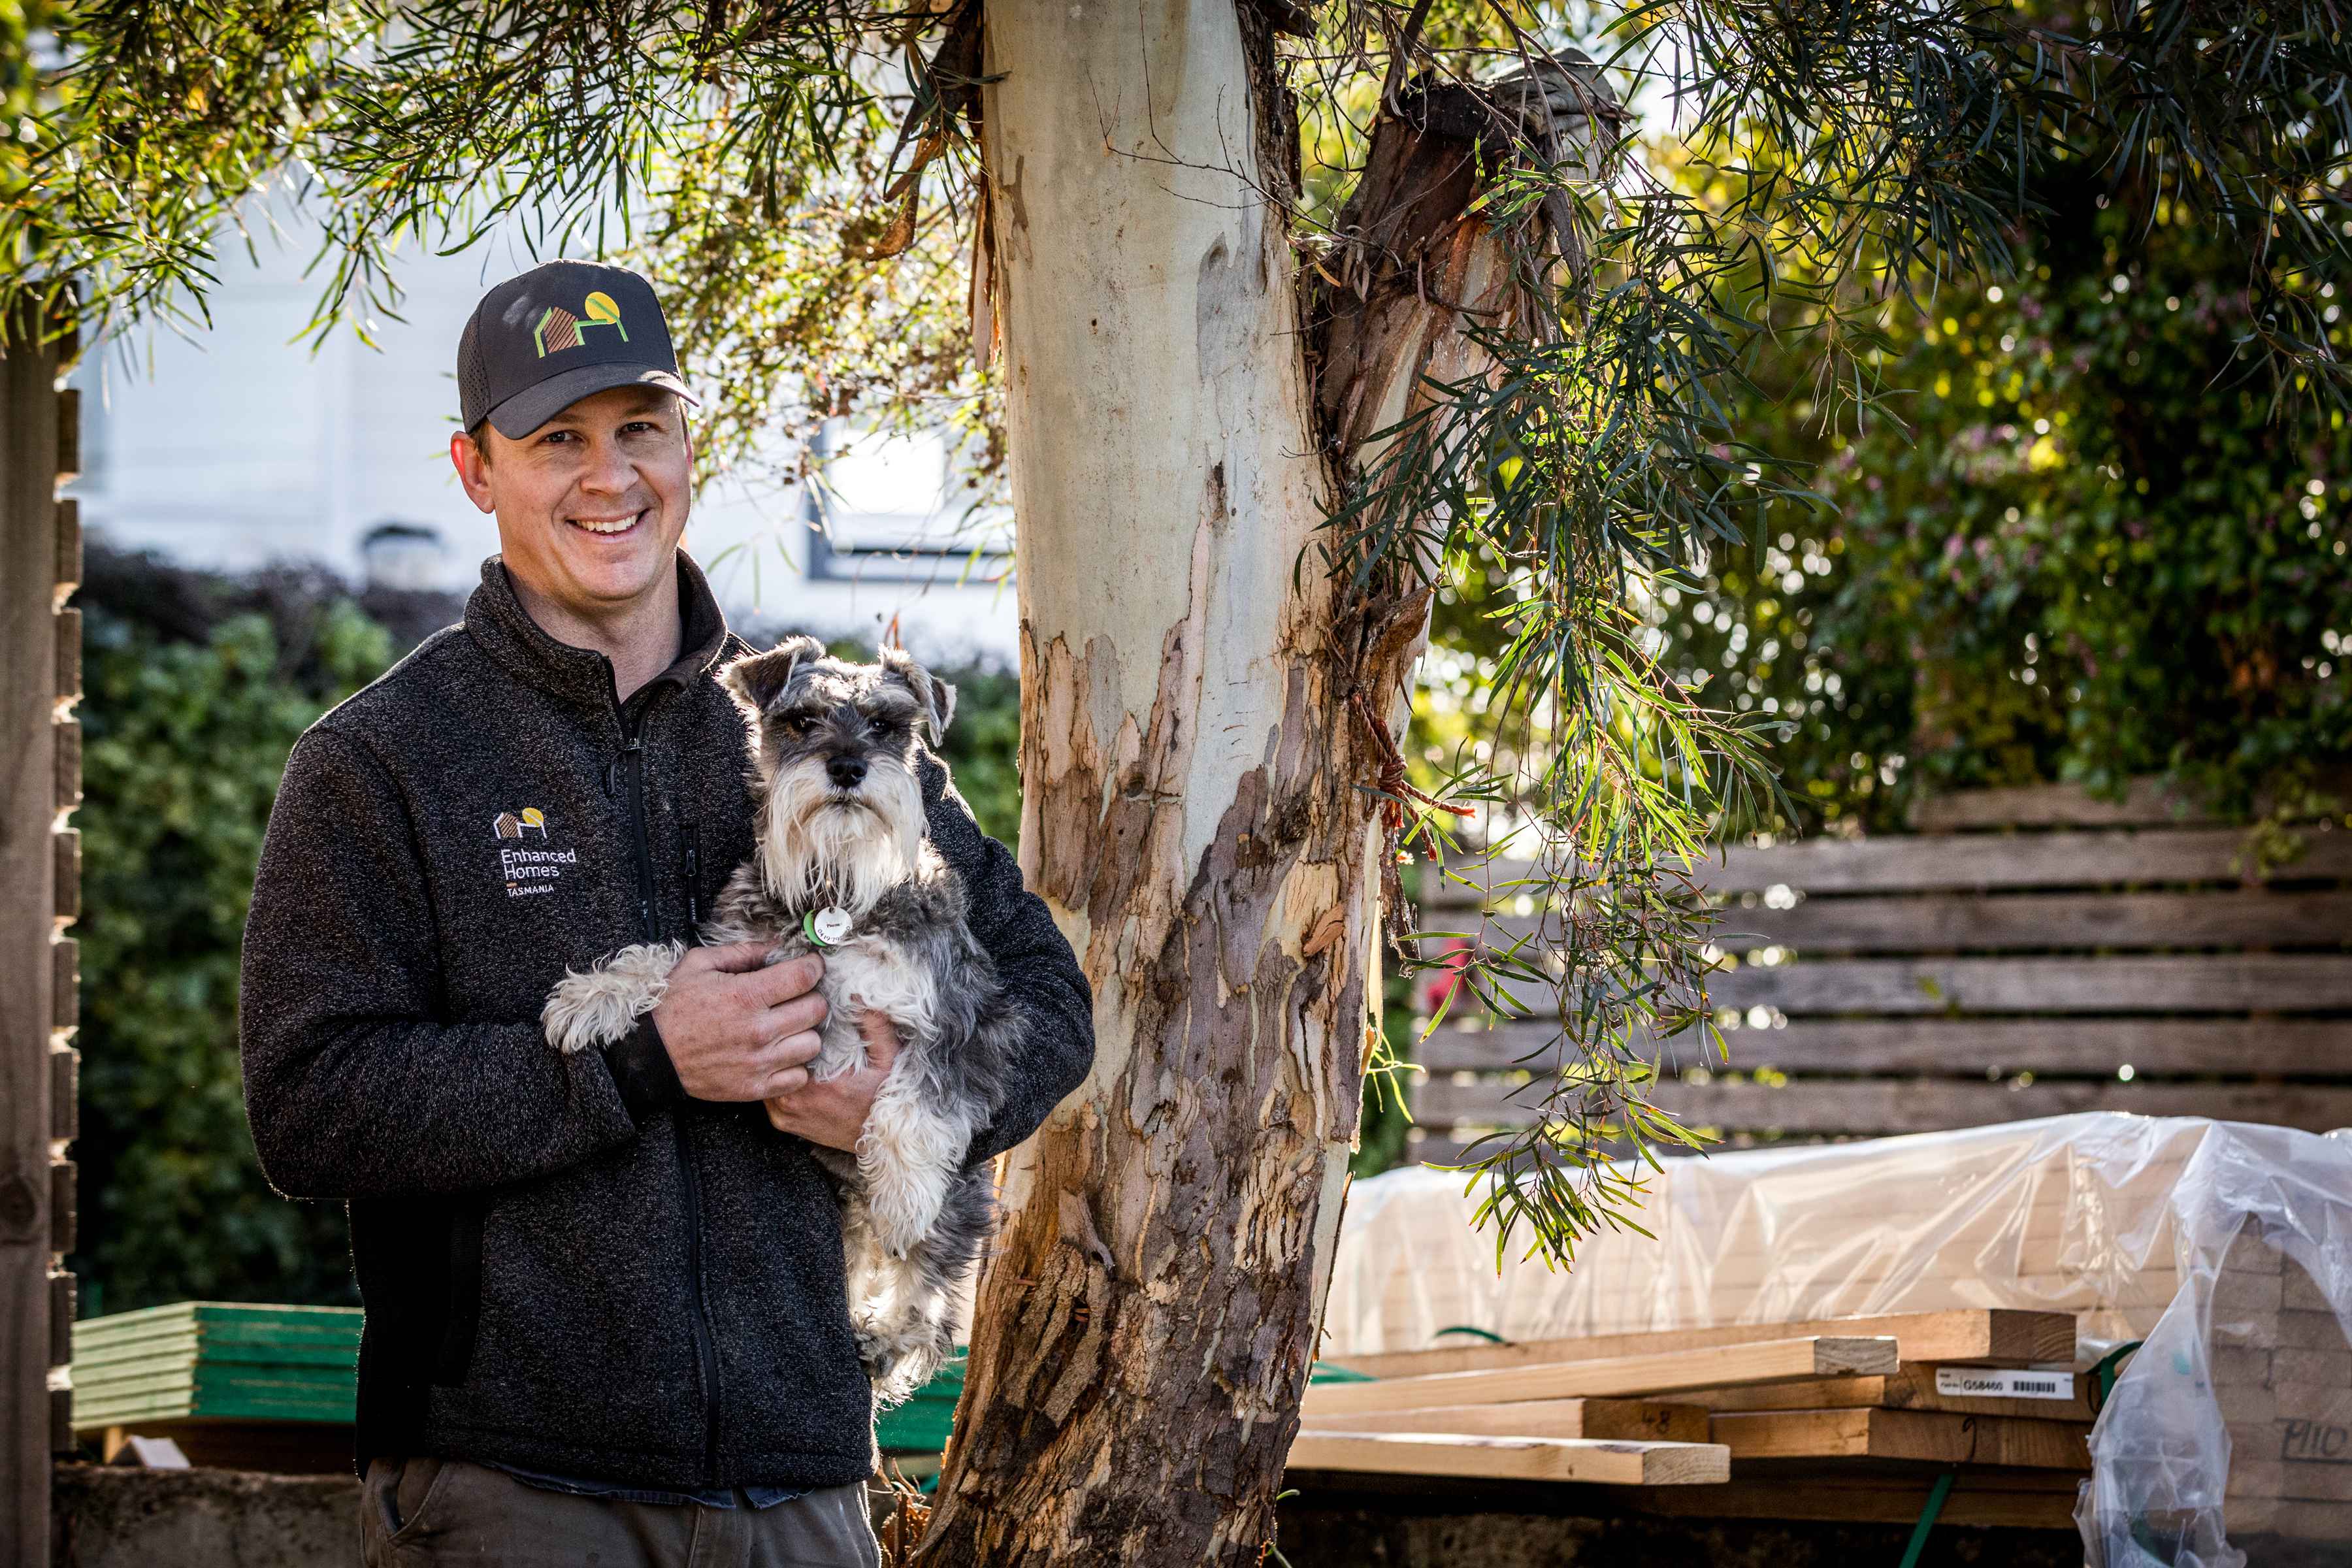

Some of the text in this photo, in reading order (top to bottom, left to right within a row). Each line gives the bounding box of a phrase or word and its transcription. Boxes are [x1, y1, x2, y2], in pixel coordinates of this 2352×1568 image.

[501, 848, 577, 864] Enhanced
[504, 864, 560, 880] Homes
[506, 884, 555, 897] TASMANIA
